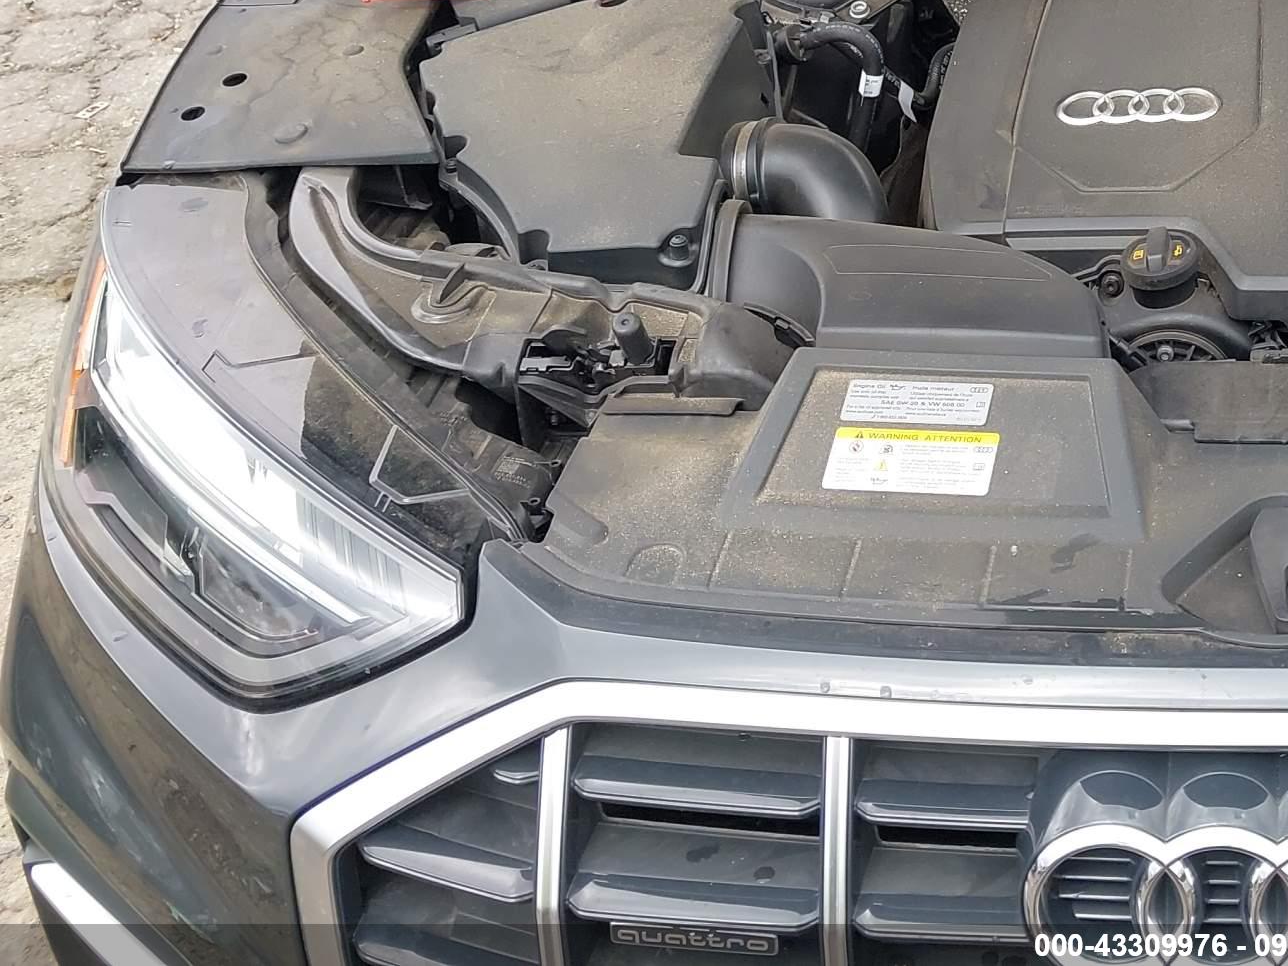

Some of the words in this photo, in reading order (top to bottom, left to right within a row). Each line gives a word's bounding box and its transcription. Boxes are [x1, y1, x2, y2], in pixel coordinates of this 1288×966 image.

[868, 432, 919, 441] WARNING
[924, 434, 982, 443] ATTENTION
[617, 929, 769, 951] quattro
